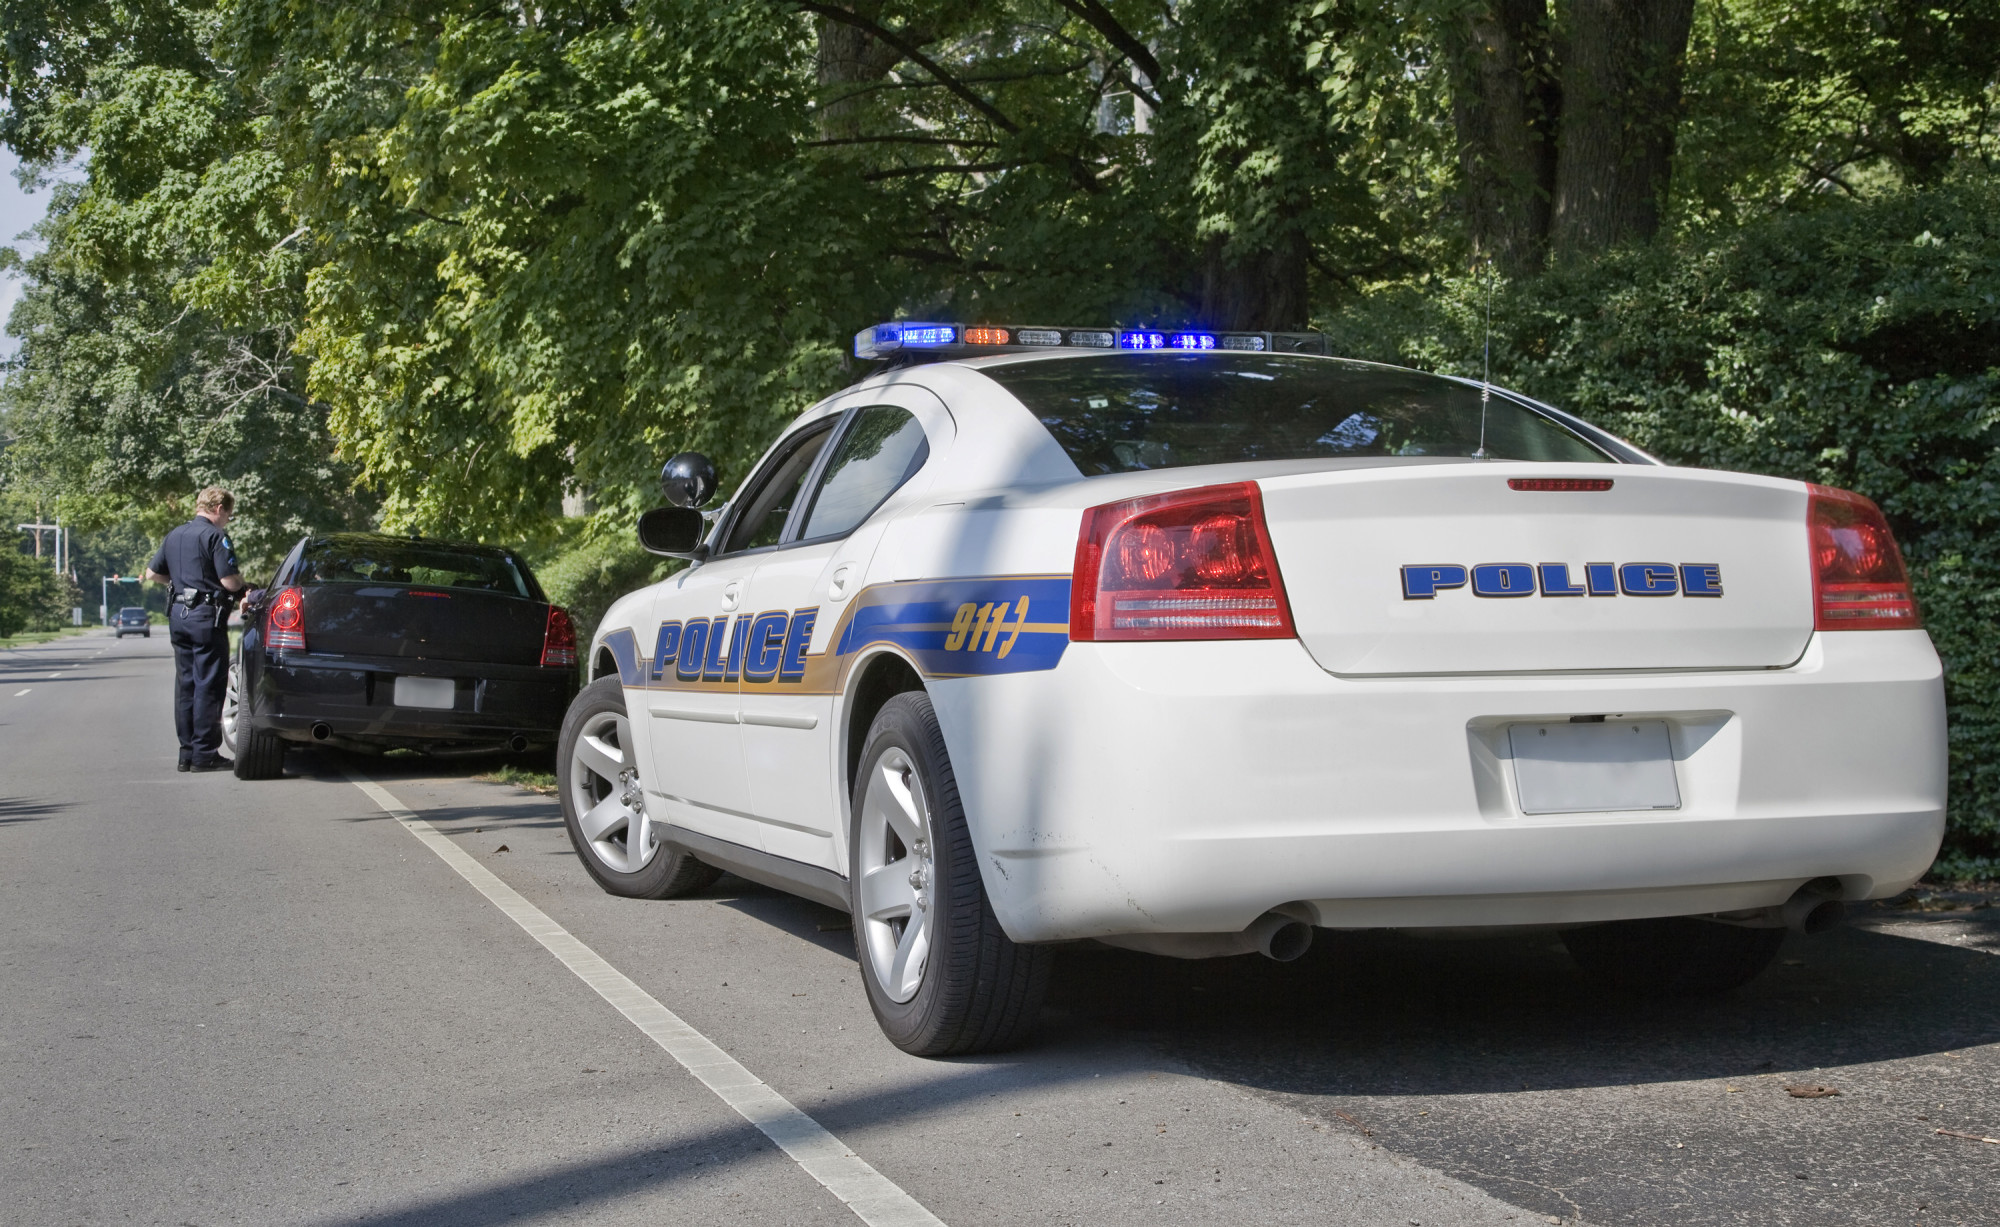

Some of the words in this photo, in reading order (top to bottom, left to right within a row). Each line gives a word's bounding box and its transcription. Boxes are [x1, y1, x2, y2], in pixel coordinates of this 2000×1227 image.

[1400, 562, 1724, 600] POLICE
[651, 605, 820, 683] POLICE
[944, 602, 1010, 652] 911
